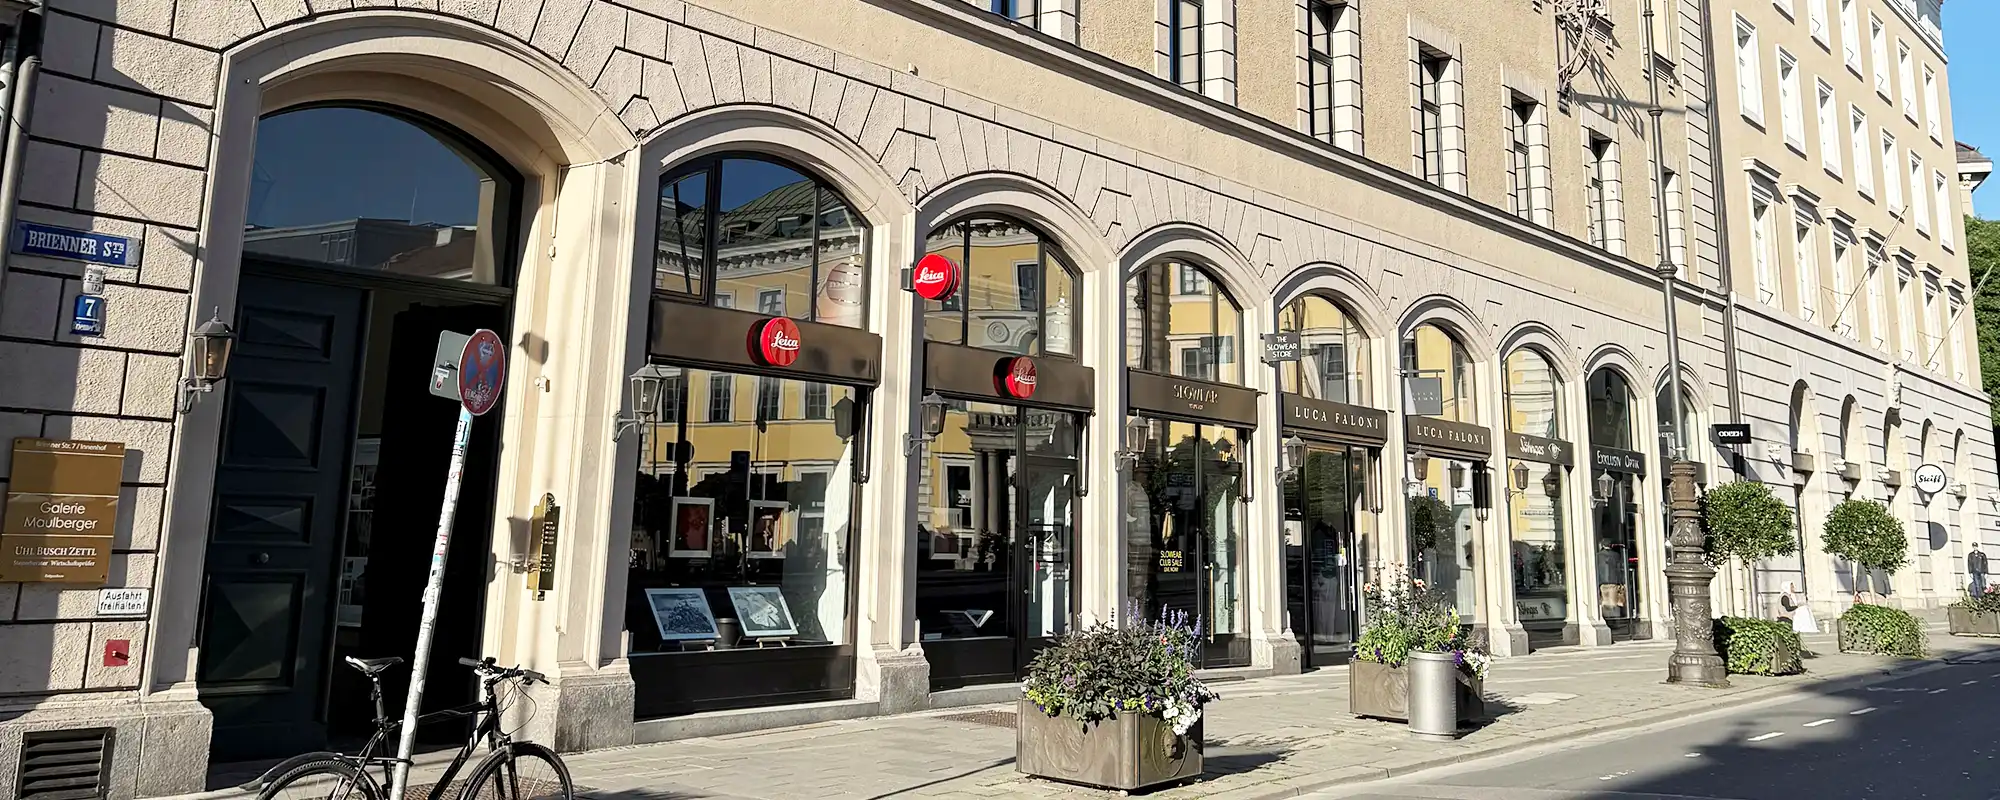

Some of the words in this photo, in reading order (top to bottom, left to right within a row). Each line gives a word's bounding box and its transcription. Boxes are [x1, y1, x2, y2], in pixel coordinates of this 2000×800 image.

[27, 230, 97, 256] BRIENNER
[916, 266, 944, 284] Leica
[85, 299, 96, 317] 7
[771, 331, 800, 350] Leica
[1266, 343, 1298, 351] SLOWEAR
[1014, 368, 1036, 385] Leica
[1295, 406, 1327, 421] LUCA
[1335, 413, 1379, 429] FALONI
[1416, 425, 1442, 439] LUCA
[1449, 430, 1484, 445] FALONI
[80, 443, 107, 451] Innenhof
[1918, 474, 1942, 483] Steiff
[40, 501, 86, 514] Galerie
[23, 516, 98, 531] Maulberger
[15, 546, 34, 556] UHL
[37, 547, 67, 556] BUSCH
[69, 546, 97, 556] ZETTL
[1160, 550, 1182, 558] SLOWEAR
[105, 591, 142, 601] Ausfahrt
[100, 600, 145, 612] freihalten!
